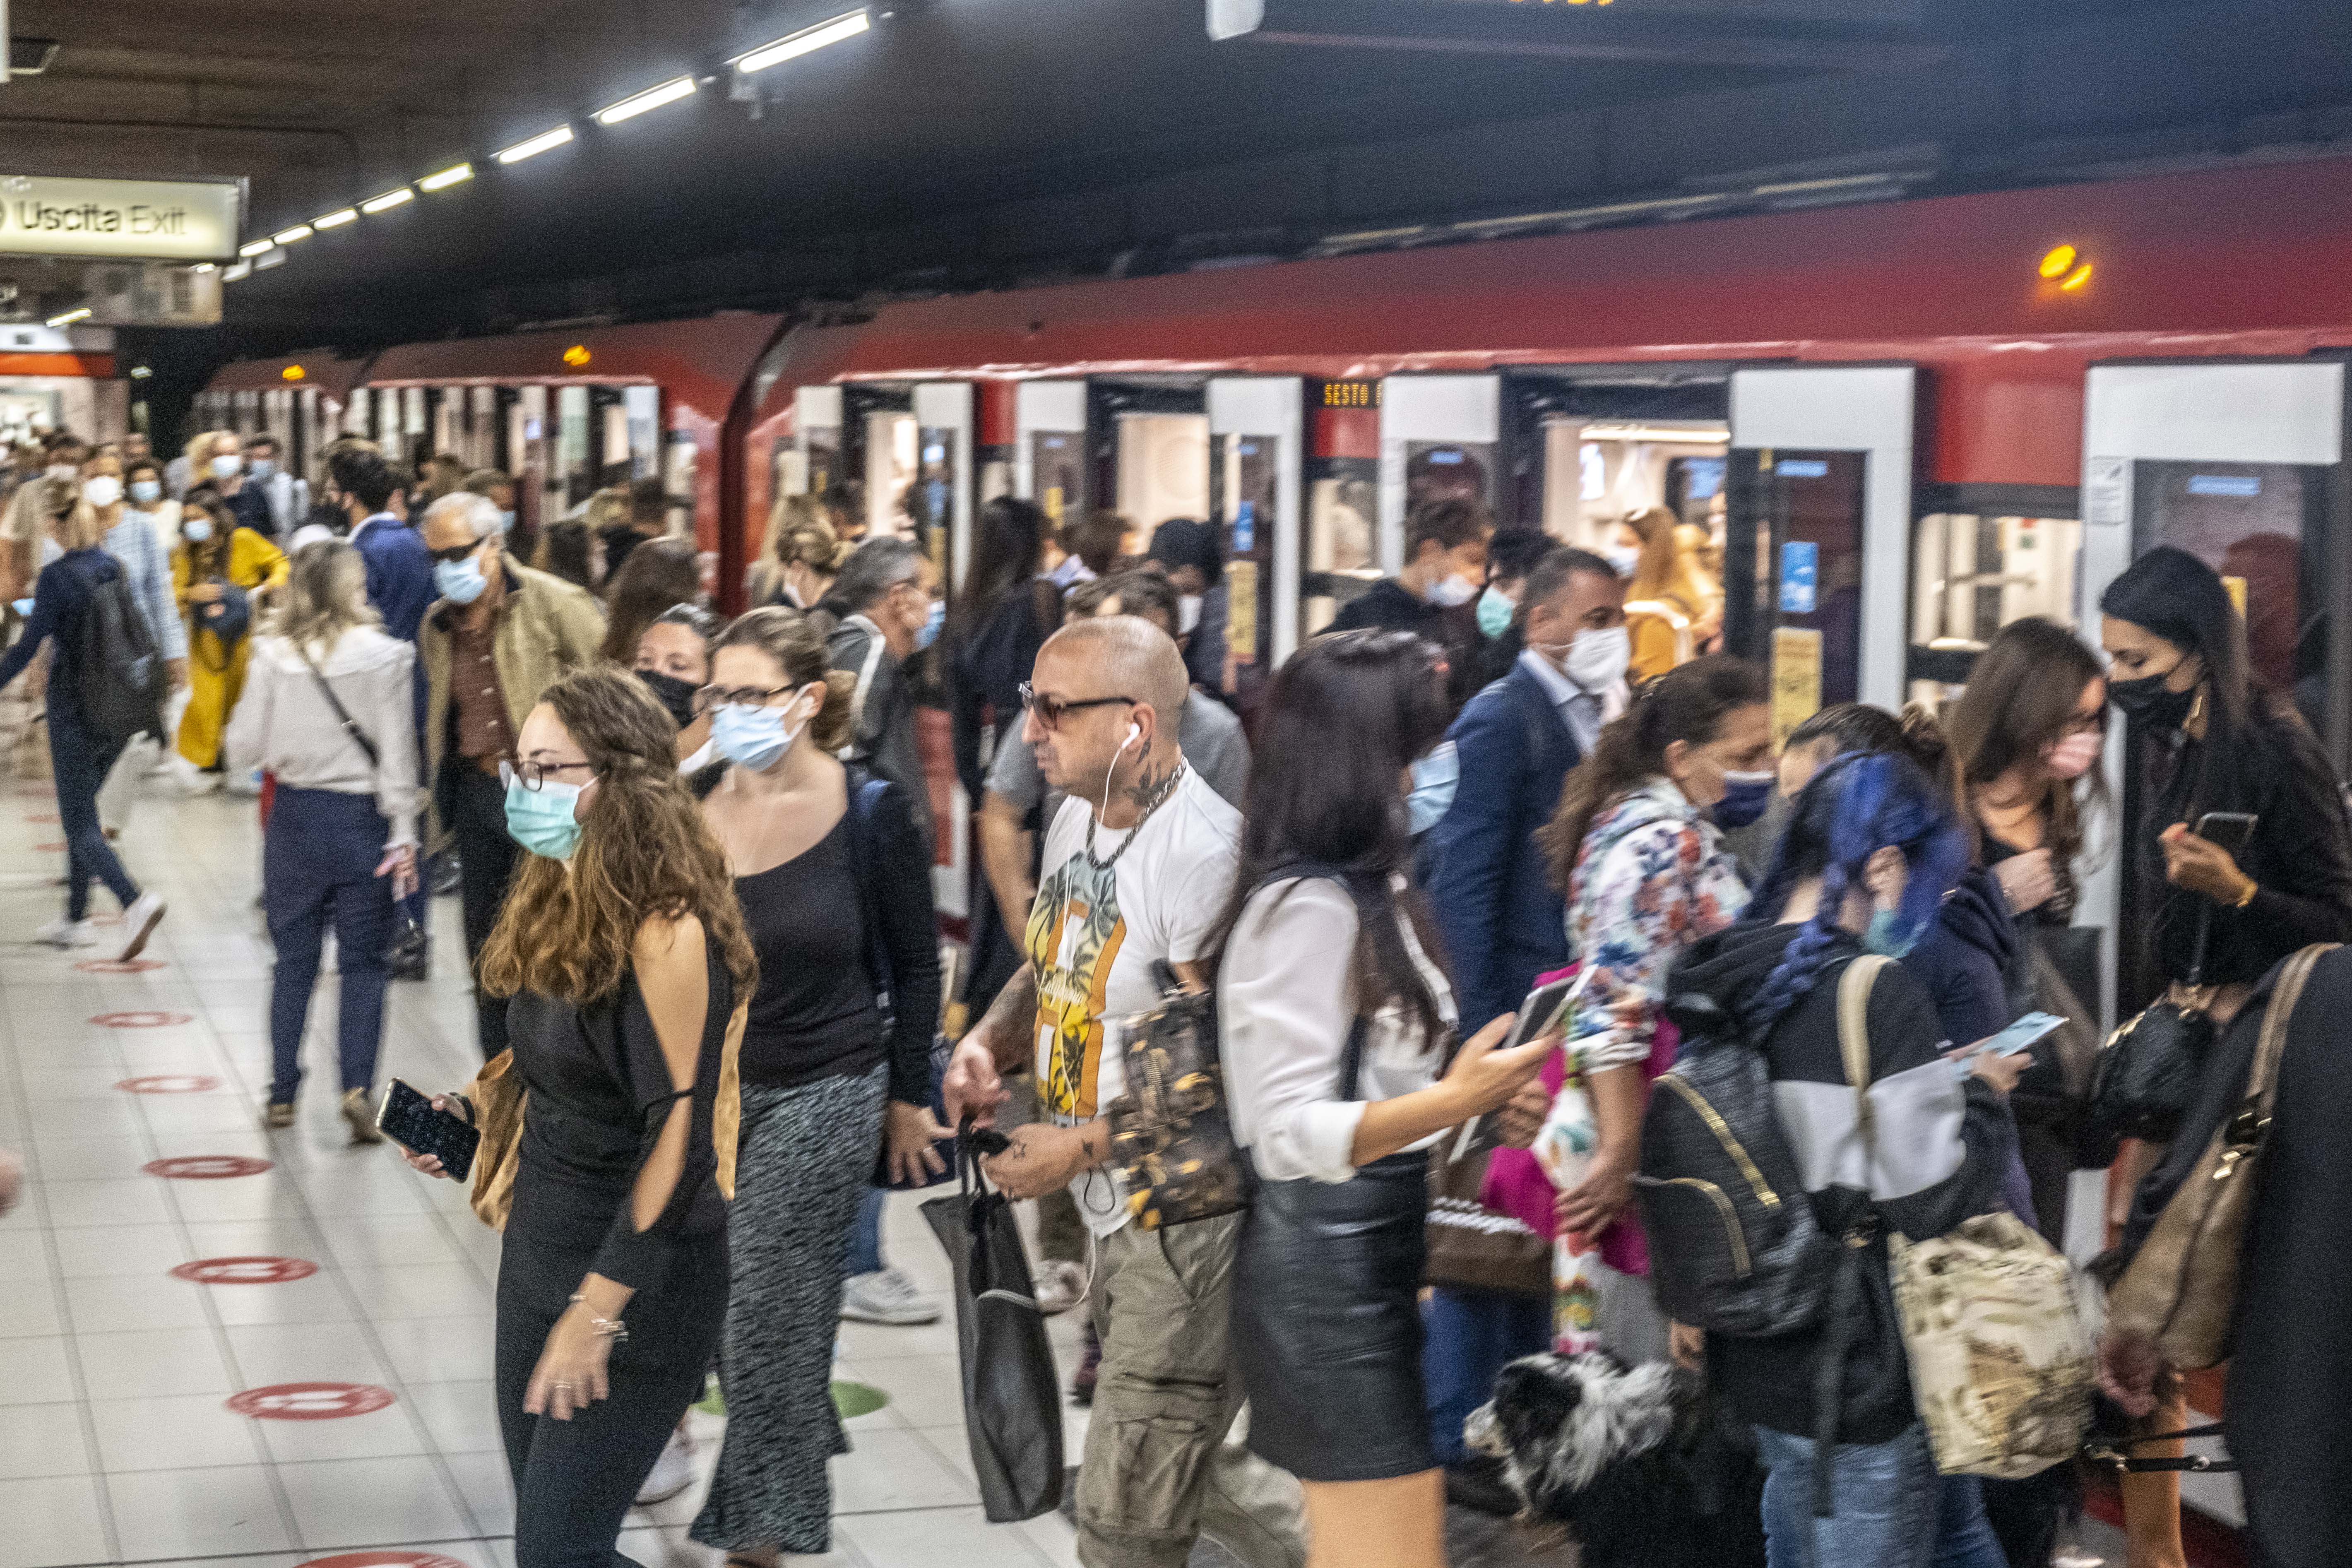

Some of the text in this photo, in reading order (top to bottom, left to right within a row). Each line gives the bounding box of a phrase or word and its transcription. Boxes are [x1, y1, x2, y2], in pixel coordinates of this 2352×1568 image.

[15, 200, 187, 234] Uscita Exit
[1325, 384, 1368, 405] SESTO
